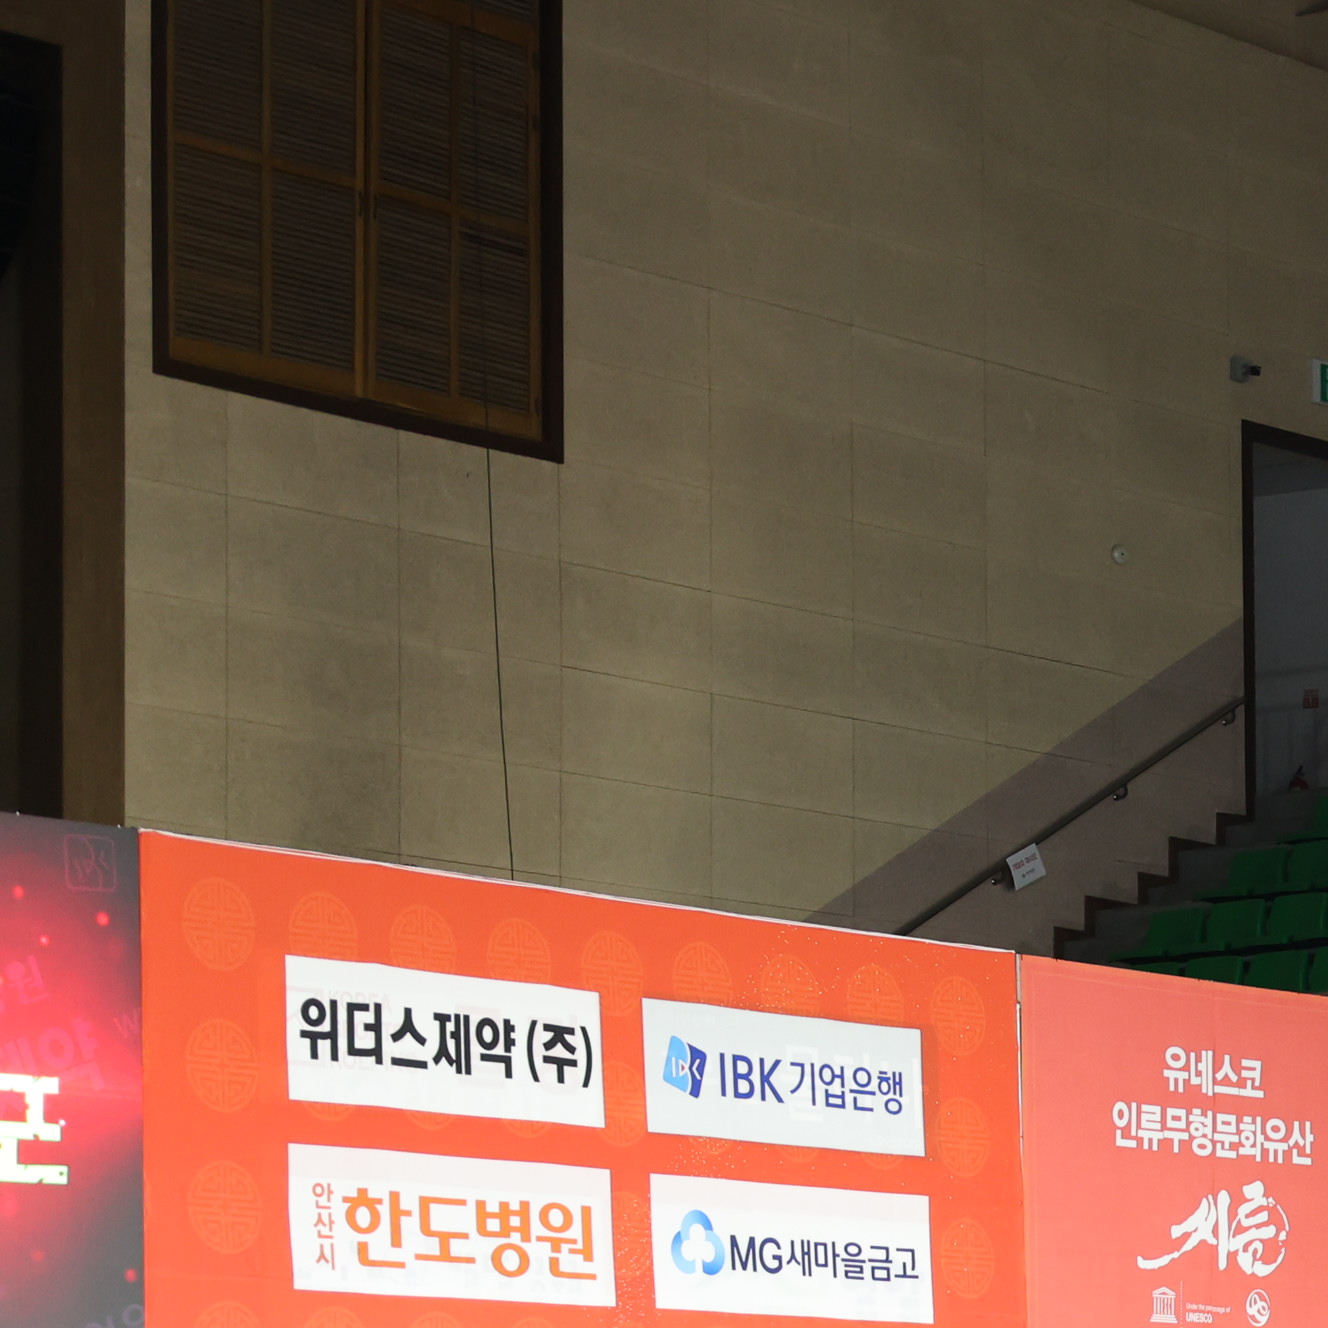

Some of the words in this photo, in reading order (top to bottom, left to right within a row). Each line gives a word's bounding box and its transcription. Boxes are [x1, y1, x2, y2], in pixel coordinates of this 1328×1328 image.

[1163, 1046, 1264, 1098] 유네스코
[1112, 1101, 1314, 1165] 인류무형문화유산
[312, 1182, 336, 1270] 안산시
[342, 1188, 597, 1280] 한도병원
[1186, 1312, 1213, 1324] UNESCO
